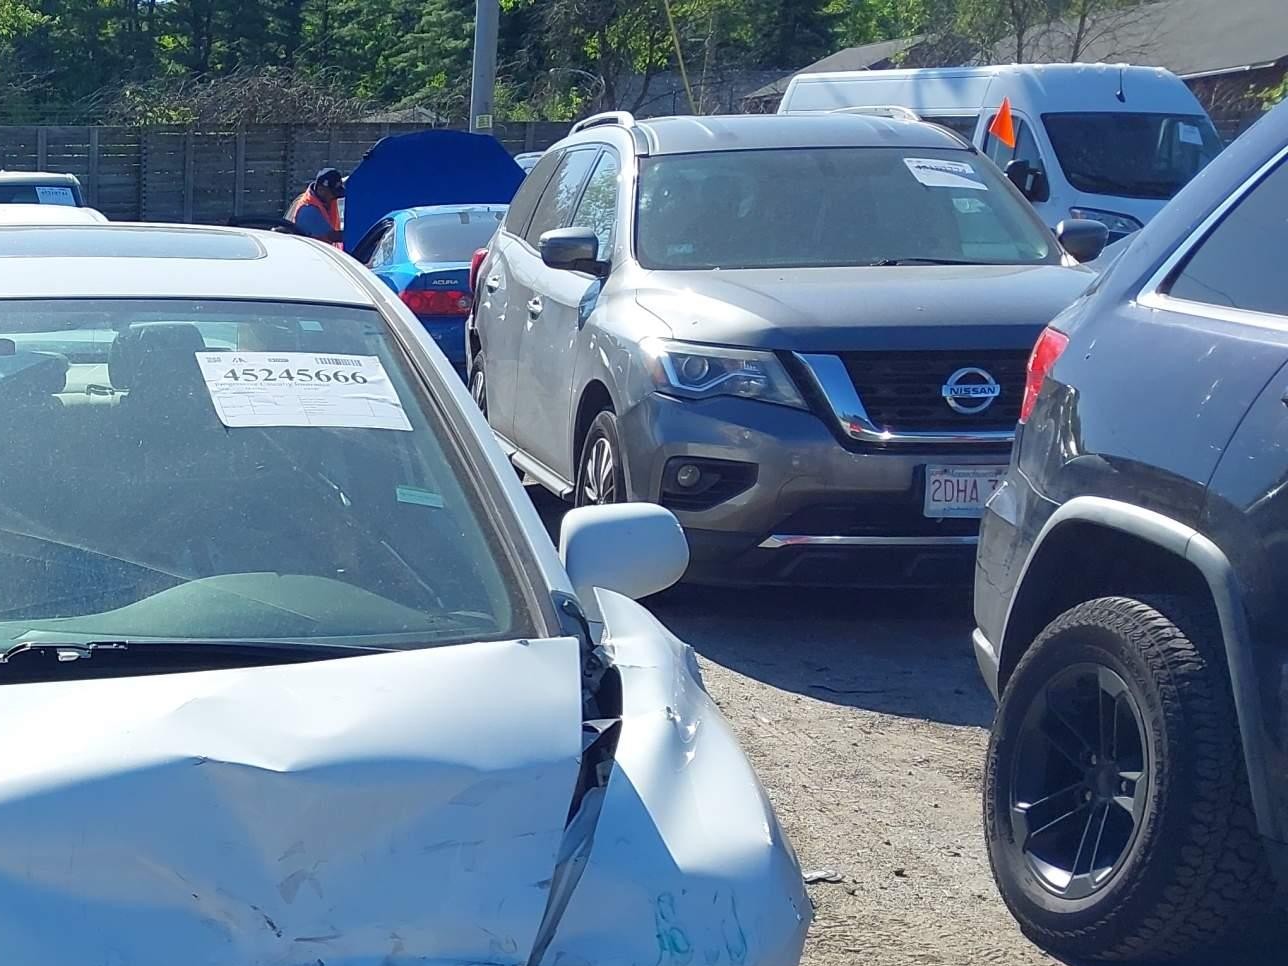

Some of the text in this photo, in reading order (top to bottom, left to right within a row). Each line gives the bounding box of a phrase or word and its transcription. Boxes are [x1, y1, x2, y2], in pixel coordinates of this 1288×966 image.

[223, 368, 368, 384] 45245666
[949, 387, 996, 395] NISSAN
[932, 479, 979, 503] 2DHA
